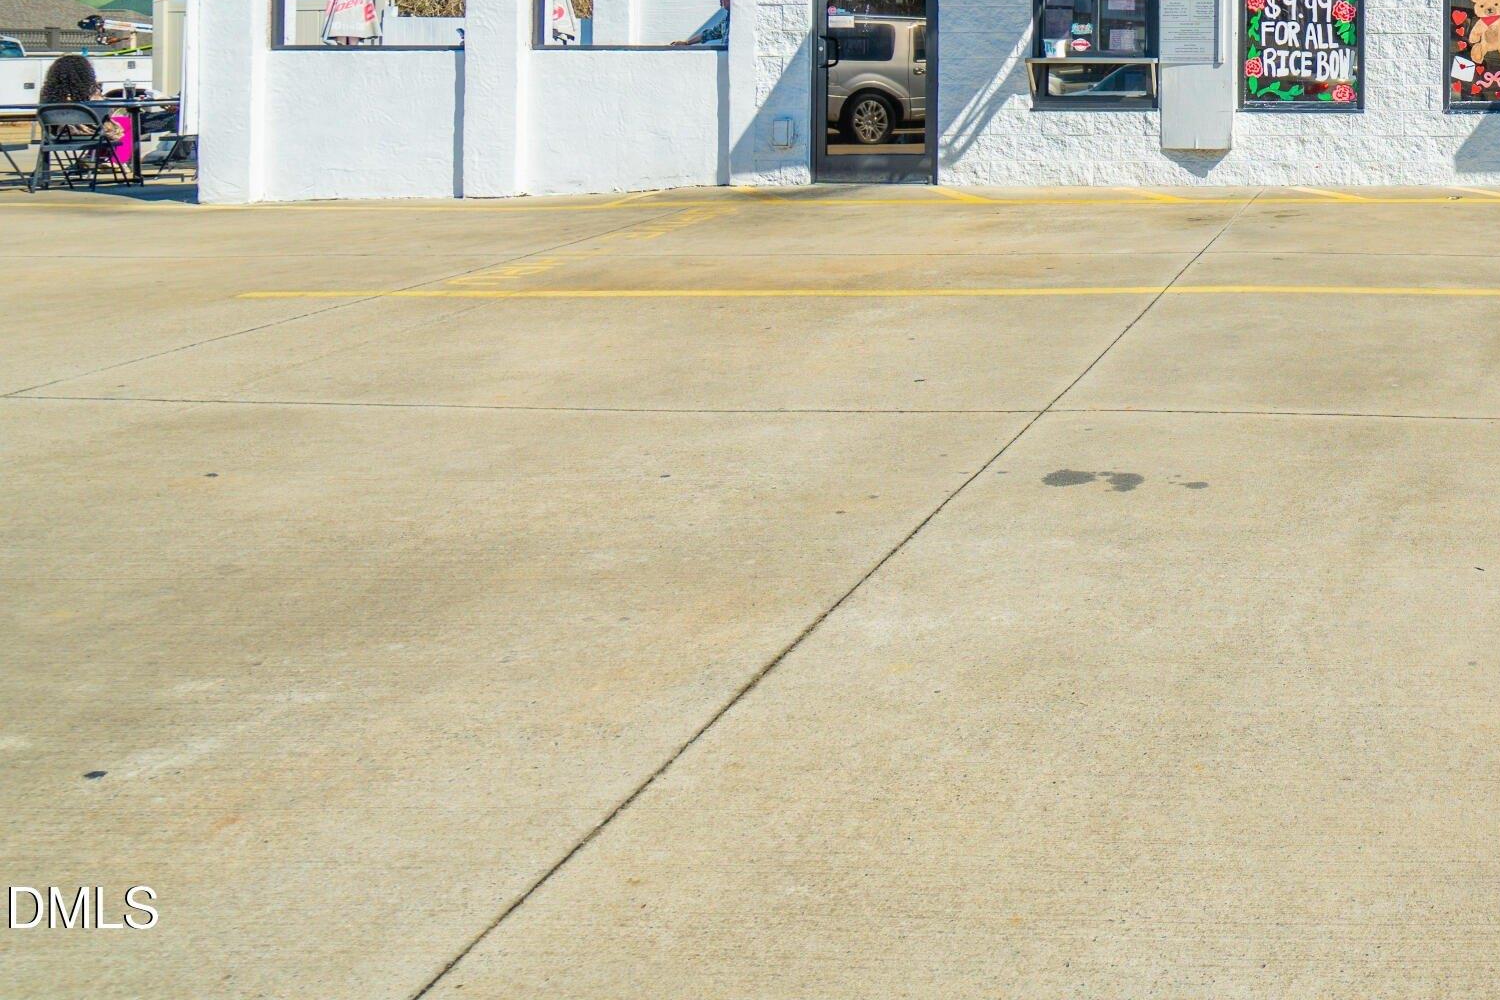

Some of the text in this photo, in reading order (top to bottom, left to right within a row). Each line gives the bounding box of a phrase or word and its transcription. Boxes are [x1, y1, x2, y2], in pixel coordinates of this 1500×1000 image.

[1260, 21, 1340, 50] FOR ALL
[1262, 47, 1314, 78] RICE
